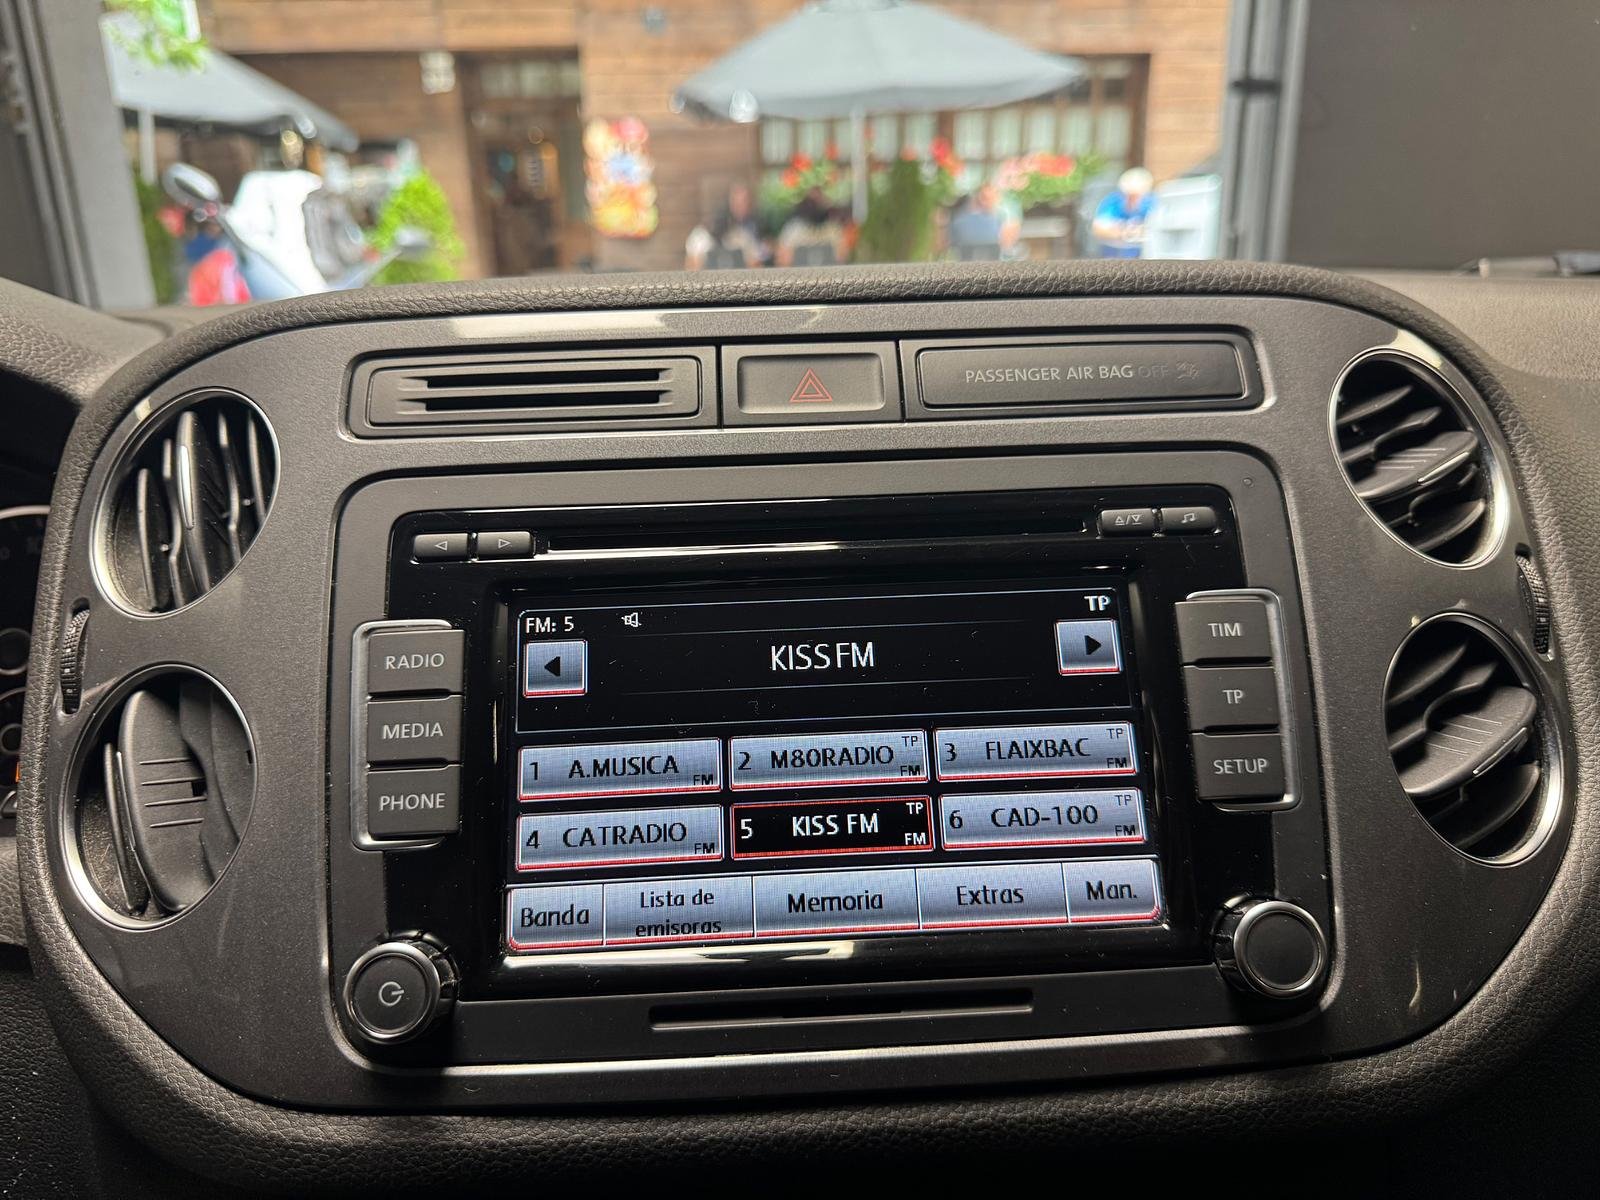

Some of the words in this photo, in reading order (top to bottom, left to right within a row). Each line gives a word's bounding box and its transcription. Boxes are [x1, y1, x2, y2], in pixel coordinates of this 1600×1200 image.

[965, 367, 1060, 383] PASSENGER
[1066, 366, 1094, 381] AIR
[1099, 364, 1134, 379] BAG
[1084, 595, 1111, 612] TP
[525, 617, 556, 633] FM:
[564, 616, 575, 632] 5
[1208, 622, 1242, 637] TIM
[385, 653, 444, 670] RADIO
[770, 643, 831, 671] KISS
[835, 641, 875, 669] FM
[1222, 689, 1244, 704] TP
[382, 722, 444, 740] MEDIA
[1106, 728, 1124, 739] TP
[901, 735, 918, 747] TP
[944, 743, 957, 762] 3
[985, 738, 1091, 760] FLAIXBAC
[529, 762, 539, 781] 1
[568, 755, 679, 779] A.MUSICA
[738, 752, 751, 771] 2
[1106, 757, 1127, 769] FM
[1213, 758, 1268, 775] SETUP
[900, 765, 921, 777] FM
[693, 774, 714, 786] FM
[379, 793, 446, 811] PHONE
[906, 802, 924, 815] TP
[1115, 794, 1132, 806] TP
[740, 818, 753, 839] 5
[792, 814, 839, 837] KISS
[847, 812, 879, 834] FM
[949, 810, 963, 829] 6
[991, 805, 1098, 828] CAD-100
[526, 830, 540, 849] 4
[562, 822, 687, 848] CATRADIO
[904, 832, 927, 845] FM
[1114, 824, 1136, 836] FM
[694, 842, 715, 854] FM
[640, 890, 685, 908] Lista
[692, 889, 715, 905] de
[956, 885, 1024, 906] Extras
[1085, 880, 1138, 901] Man.
[787, 890, 883, 913] Memoria
[520, 904, 590, 928] Banda
[635, 919, 722, 937] emisoras
